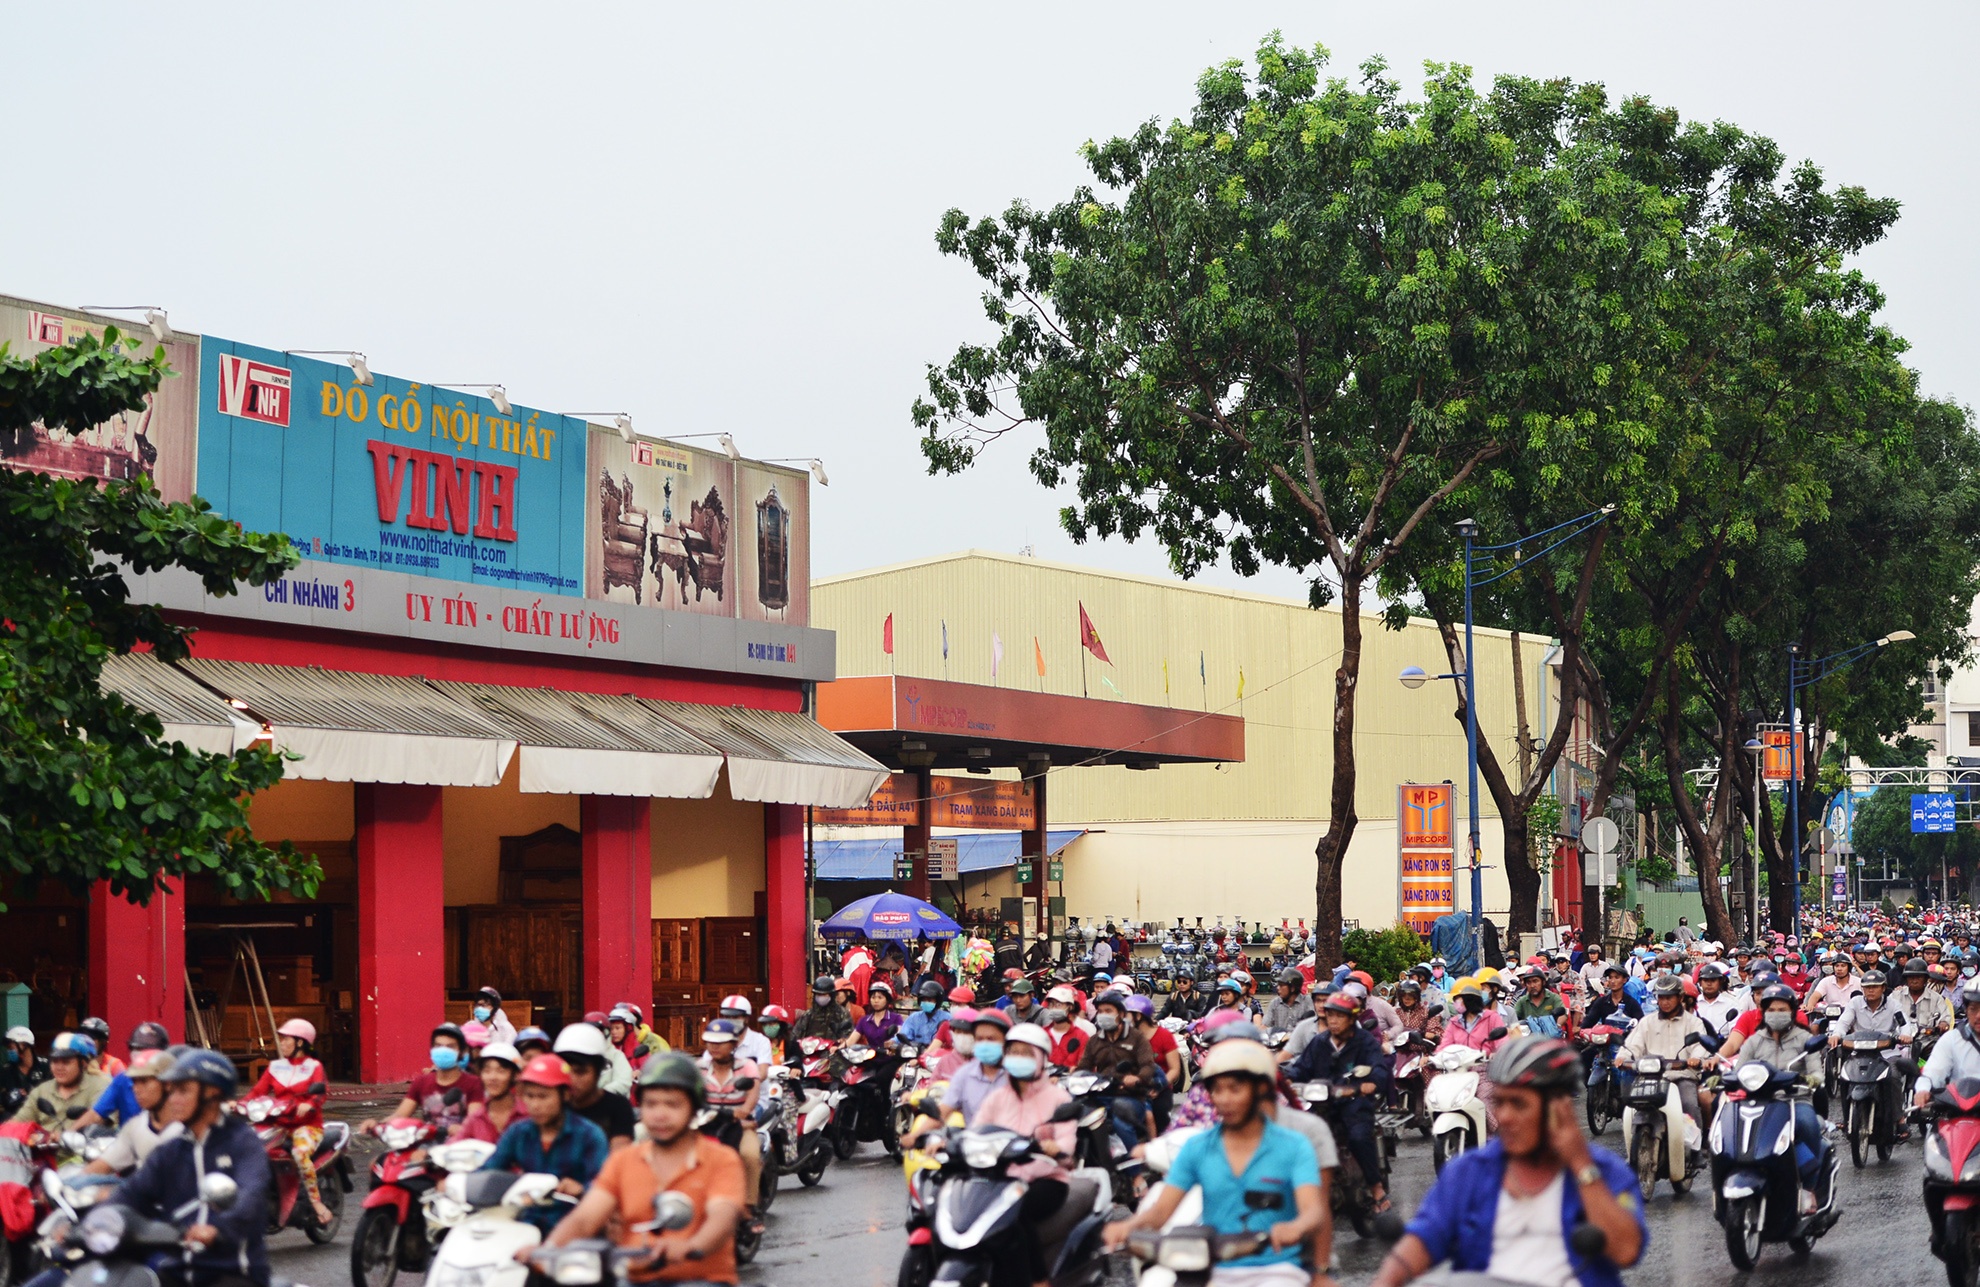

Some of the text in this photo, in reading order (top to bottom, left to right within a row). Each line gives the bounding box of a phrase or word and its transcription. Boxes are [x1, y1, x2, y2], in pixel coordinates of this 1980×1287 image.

[222, 354, 280, 418] VINH
[377, 383, 422, 433] GỖ
[431, 401, 480, 451] NỘI
[485, 412, 556, 460] THẤT
[367, 439, 519, 542] VINH
[380, 530, 506, 564] www.noithatvinh.com
[265, 577, 355, 612] CHI NHÁNH 3
[406, 593, 434, 622] UY
[442, 592, 478, 628] TÍN
[502, 598, 554, 636] CHẤT
[560, 609, 619, 649] LƯỢNG
[899, 803, 915, 812] A41
[949, 803, 973, 818] TRẠM
[1000, 802, 1017, 817] DẦU
[1019, 808, 1033, 818] A41
[1405, 835, 1448, 844] MIPECORP
[1425, 859, 1440, 871] RON
[1441, 859, 1451, 871] 95
[1425, 889, 1440, 902] RON
[1441, 889, 1451, 902] 92
